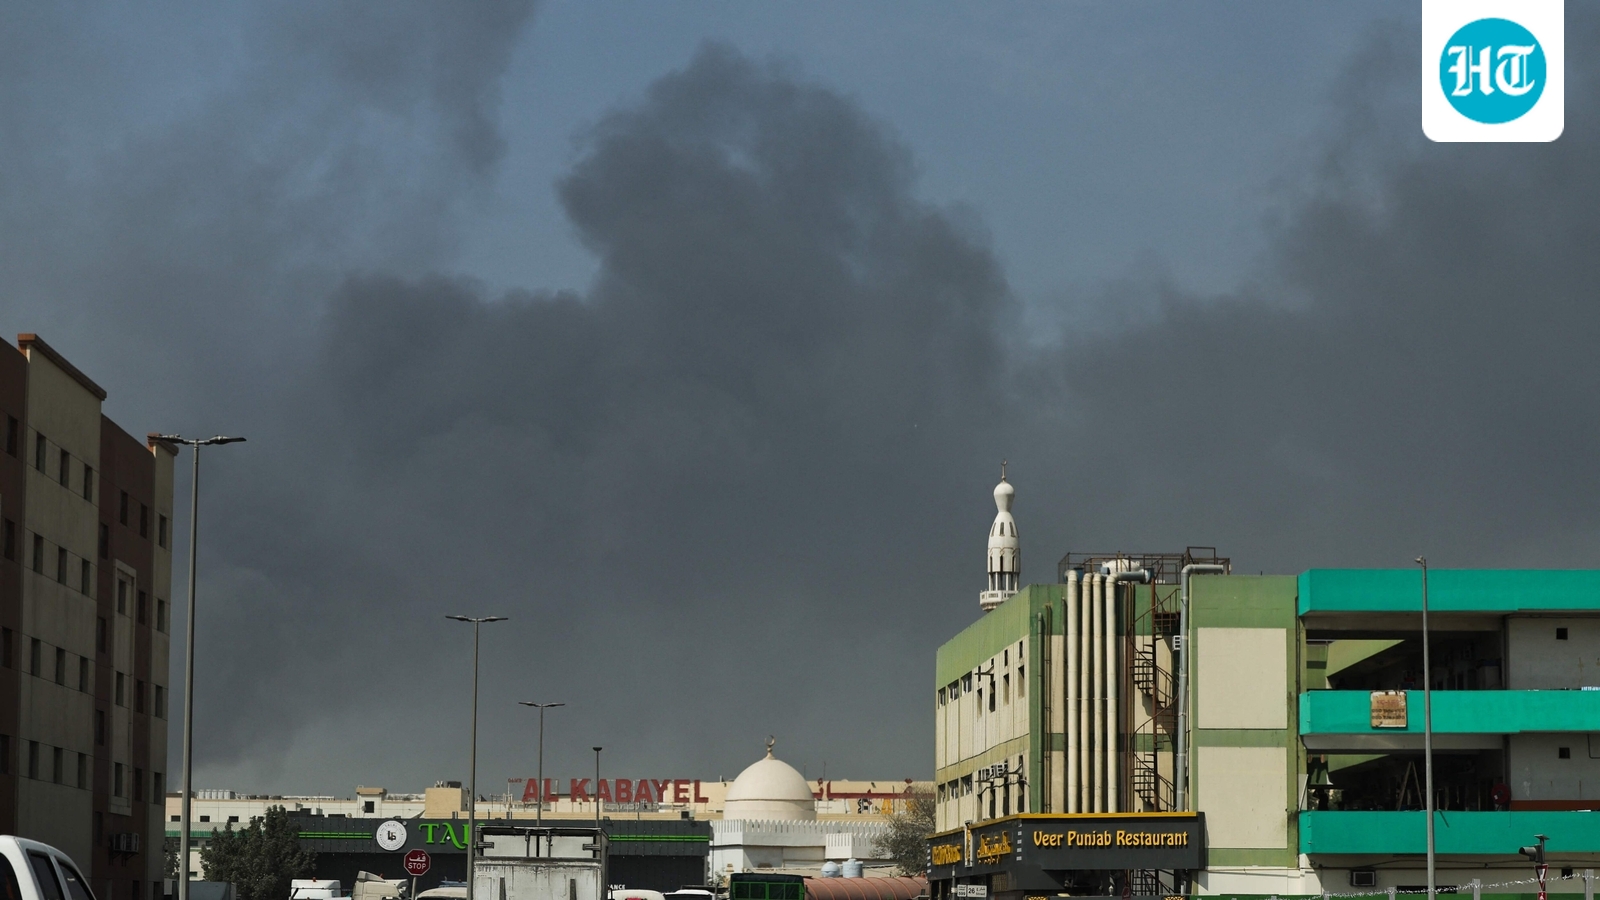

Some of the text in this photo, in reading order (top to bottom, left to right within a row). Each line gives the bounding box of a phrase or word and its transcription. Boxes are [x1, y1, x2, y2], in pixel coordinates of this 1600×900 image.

[522, 778, 709, 803] AL KABAYEL
[1033, 830, 1188, 847] Veer Punjab Restaurant
[409, 853, 426, 862] قف
[408, 862, 427, 870] STOP
